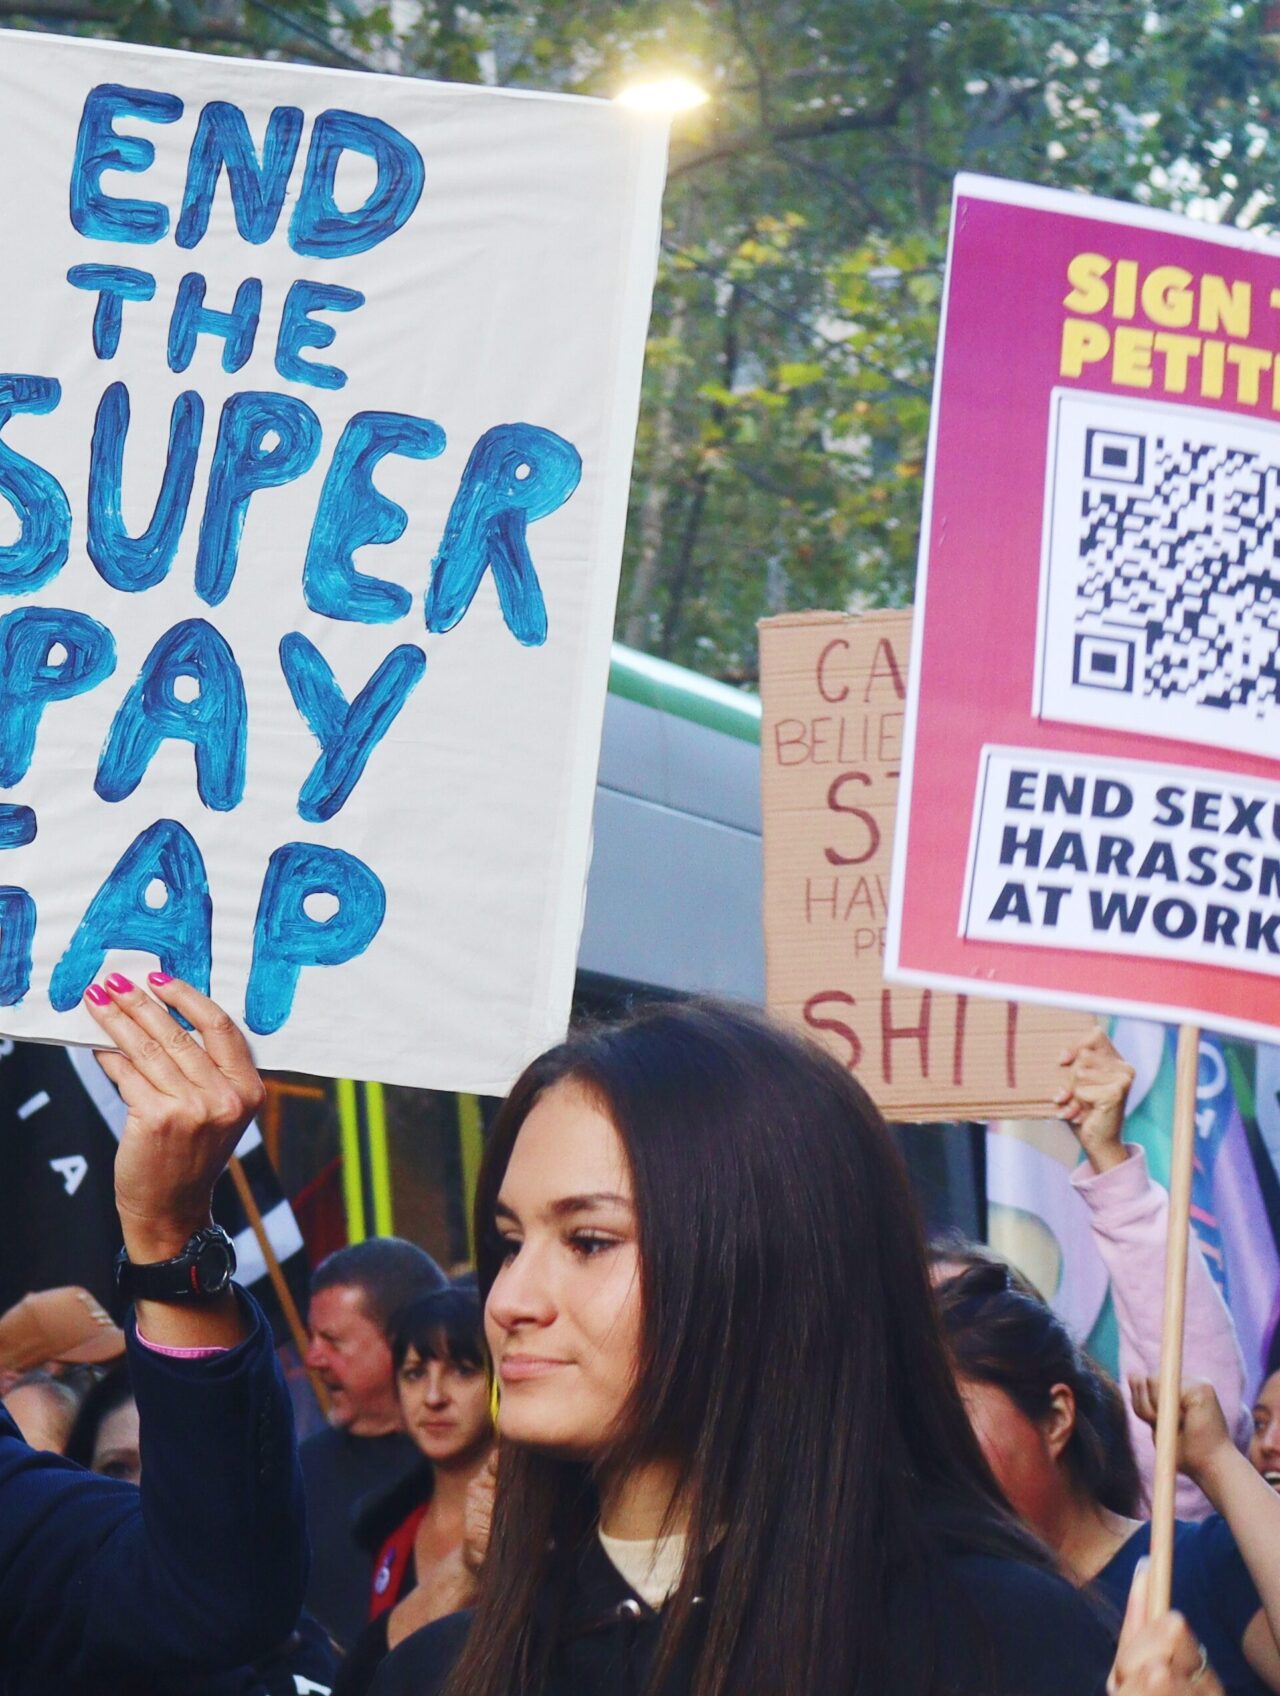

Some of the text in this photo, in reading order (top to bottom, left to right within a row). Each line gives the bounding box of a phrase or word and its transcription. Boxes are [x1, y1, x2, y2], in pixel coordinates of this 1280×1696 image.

[69, 83, 425, 260] END
[67, 262, 366, 392] THE
[1062, 252, 1252, 339] SIGN
[1006, 769, 1280, 841] END SEX
[987, 882, 1280, 954] AT WORK
